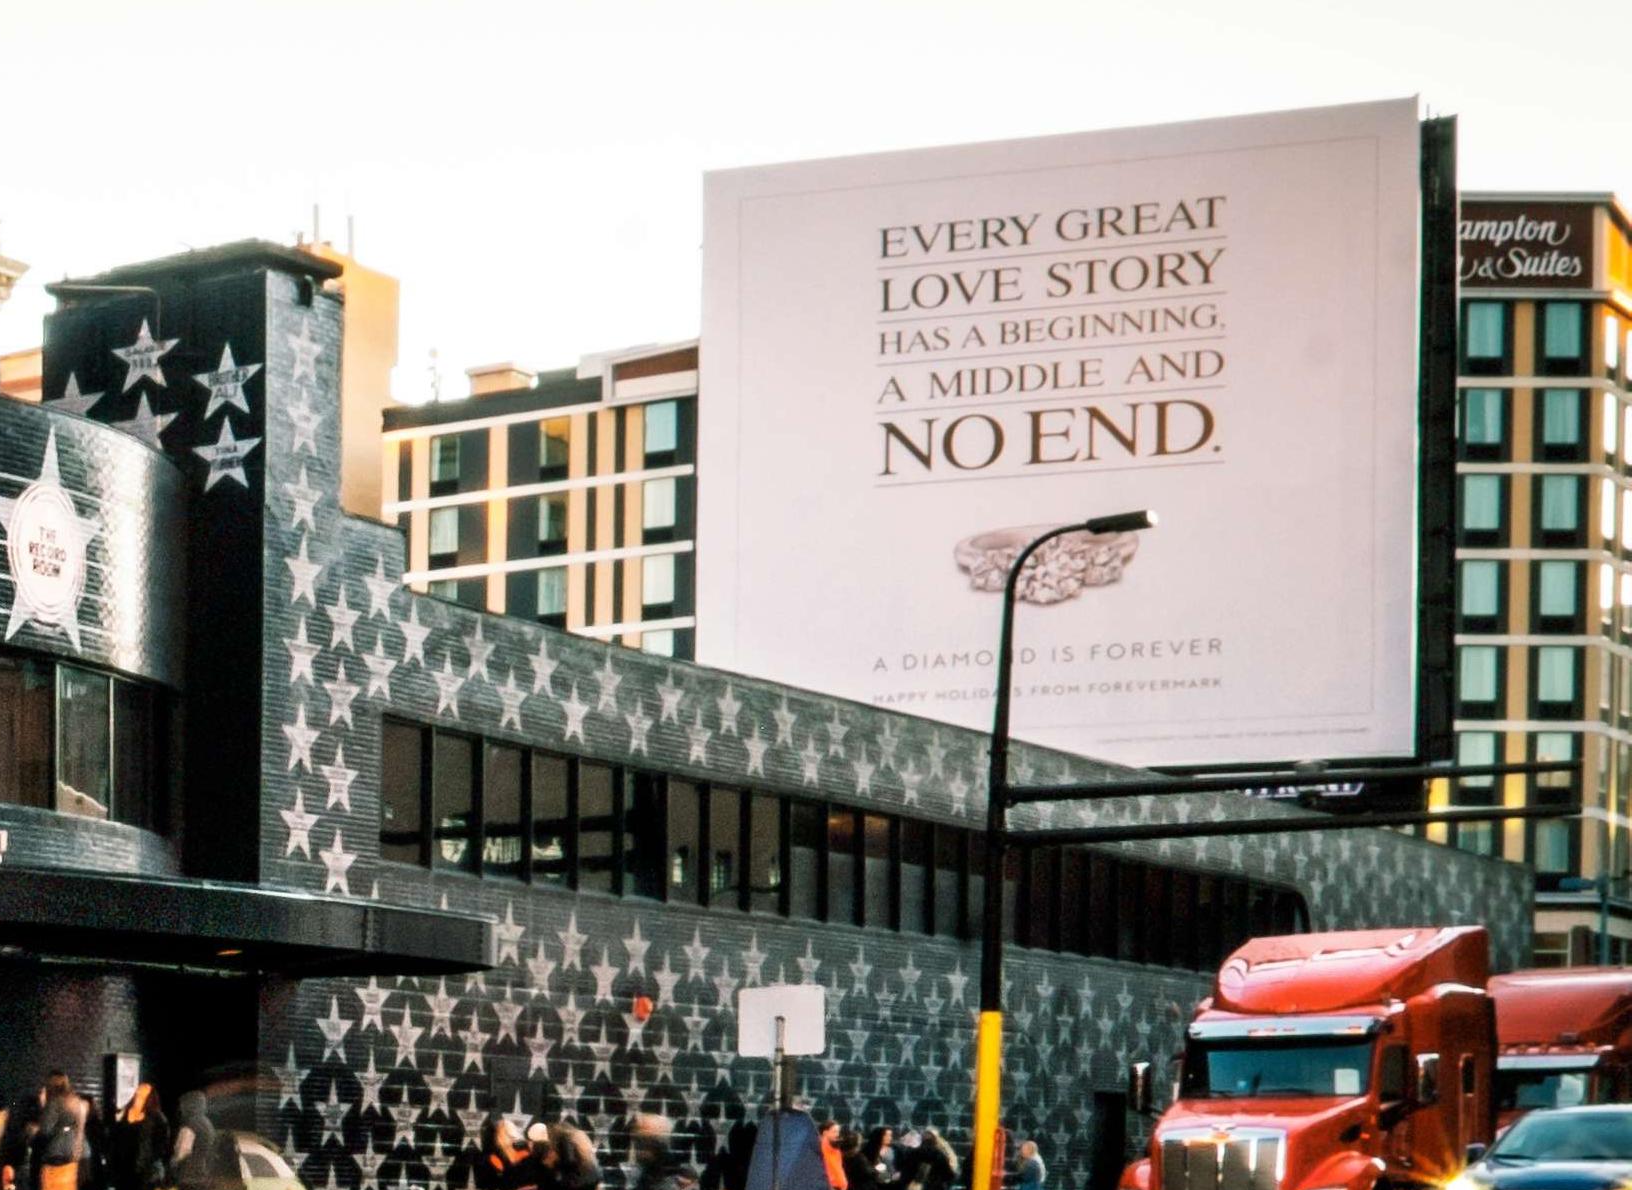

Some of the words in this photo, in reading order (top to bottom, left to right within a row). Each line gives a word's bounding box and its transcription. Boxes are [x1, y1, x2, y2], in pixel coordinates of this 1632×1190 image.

[879, 213, 1041, 259] EVERY
[1055, 195, 1227, 242] GREAT
[1459, 215, 1571, 247] ampton
[880, 266, 1024, 313] LOVE
[1046, 247, 1226, 299] STORY
[1478, 257, 1497, 279] &
[1497, 247, 1582, 278] Suites
[879, 327, 950, 356] HAS
[961, 325, 987, 348] A
[1000, 303, 1227, 345] BEGINNING,
[877, 376, 907, 404] A
[929, 358, 1105, 400] MIDDLE
[1124, 350, 1225, 385] AND
[878, 413, 1005, 476] NO
[1023, 399, 1222, 466] END.
[873, 657, 888, 672] A
[902, 646, 1037, 671] DIAMOD
[1051, 645, 1074, 664] IS
[1089, 637, 1224, 661] FOREVER
[873, 690, 929, 704] HAPPY
[936, 686, 1022, 701] HOLIDS
[1030, 684, 1081, 697] FROM
[1088, 677, 1223, 695] FOREVERMARK
